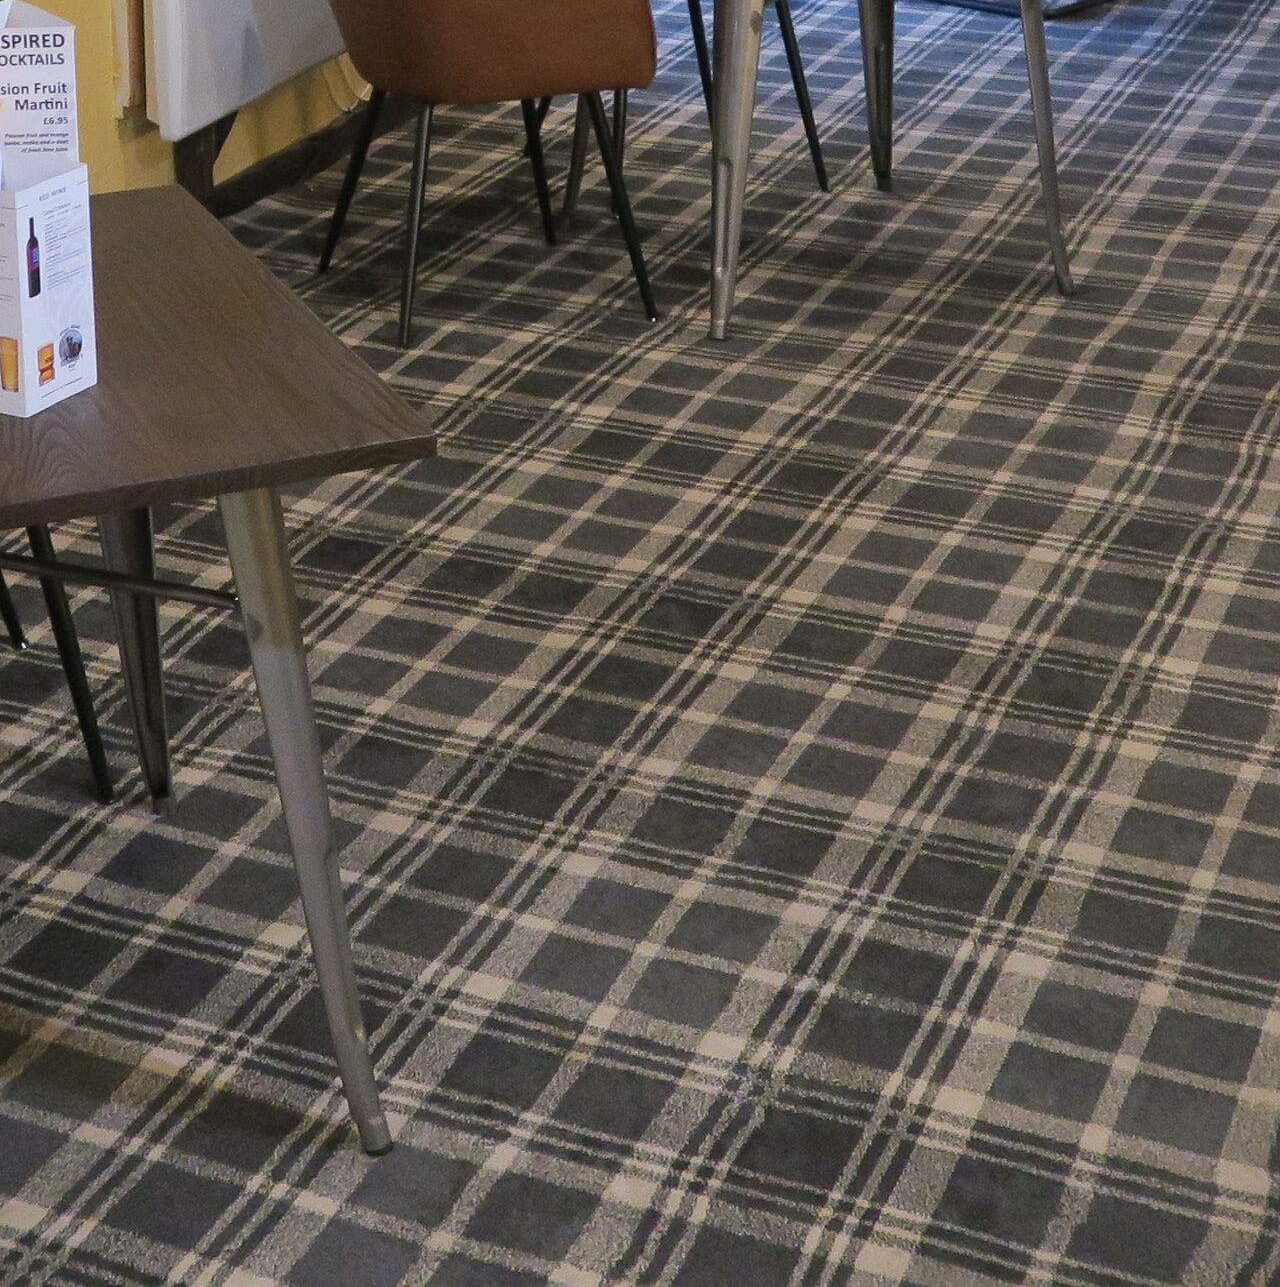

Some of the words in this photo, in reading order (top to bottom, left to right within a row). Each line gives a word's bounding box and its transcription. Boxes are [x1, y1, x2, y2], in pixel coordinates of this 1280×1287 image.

[34, 82, 68, 94] Fruit
[15, 98, 68, 110] Martini
[43, 117, 69, 125] £6.95
